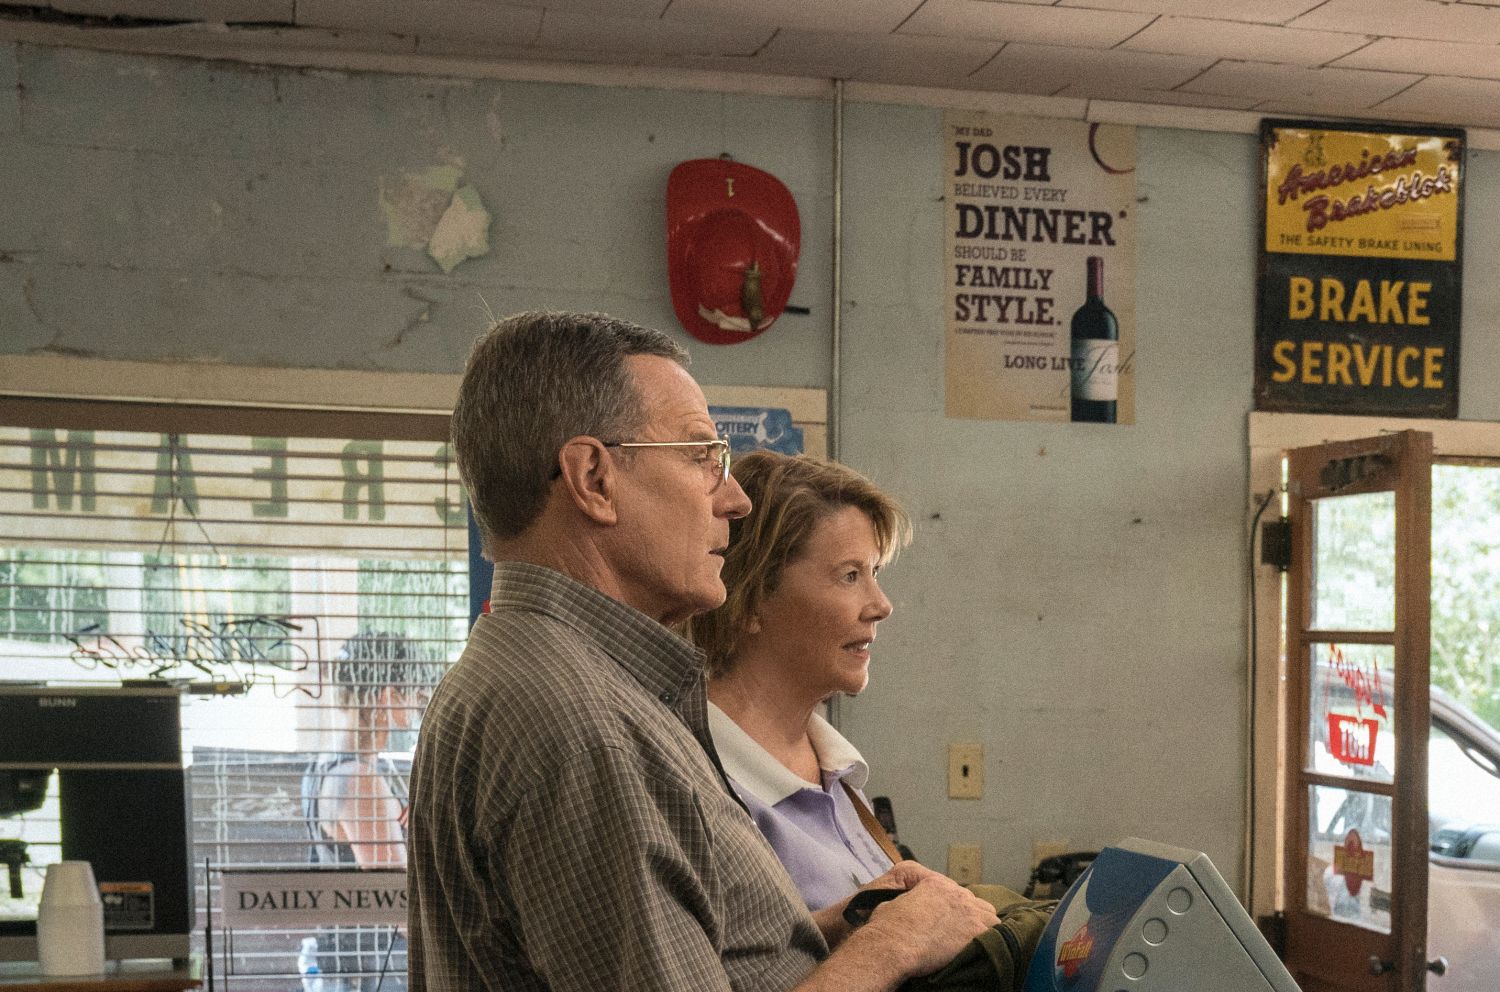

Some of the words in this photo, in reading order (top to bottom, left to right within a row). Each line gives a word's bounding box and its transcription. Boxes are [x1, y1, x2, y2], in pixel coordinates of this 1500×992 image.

[955, 142, 1051, 182] JOSH
[1278, 149, 1418, 205] American
[954, 183, 1019, 200] BELIEVED
[1024, 187, 1067, 202] EVERY
[955, 203, 1116, 246] DINNER
[954, 246, 1008, 261] SHOULD
[1010, 248, 1027, 262] BE
[1279, 234, 1302, 246] THE
[1307, 235, 1353, 248] SAFETY
[1358, 238, 1400, 250] BRAKE
[1403, 241, 1443, 253] LINING
[955, 264, 1053, 290] FAMILY
[955, 294, 1062, 326] STYLE.
[1288, 276, 1433, 326] BRAKE
[1004, 355, 1047, 370] LONG
[1051, 357, 1086, 372] LIVE
[1271, 340, 1446, 390] SERVICE
[716, 422, 759, 434] OTTERY
[238, 889, 324, 910] DAILY
[333, 889, 407, 910] NEWS
